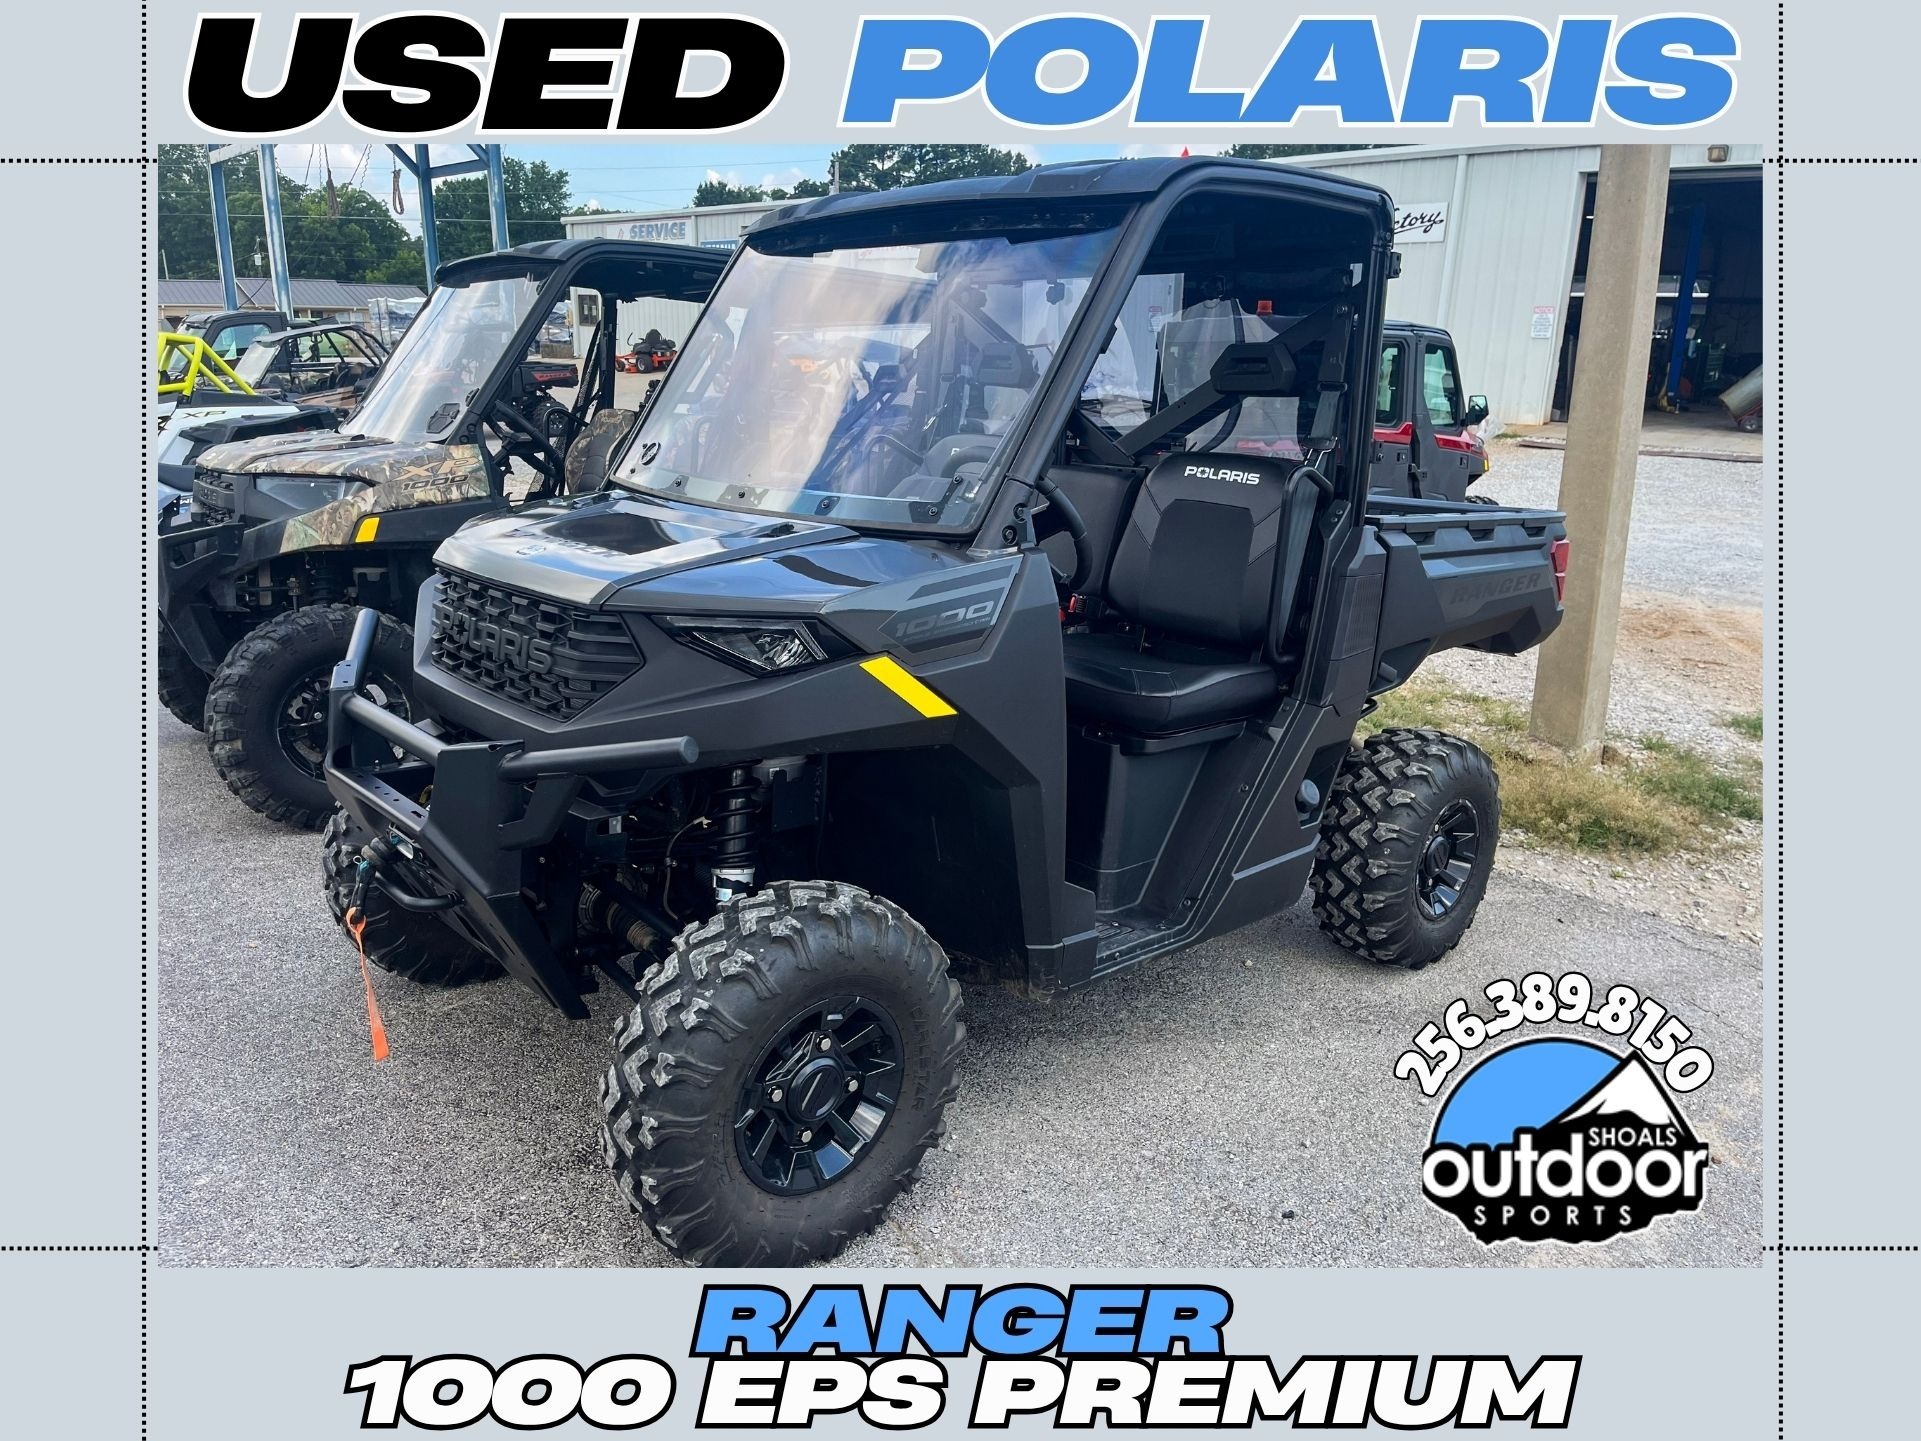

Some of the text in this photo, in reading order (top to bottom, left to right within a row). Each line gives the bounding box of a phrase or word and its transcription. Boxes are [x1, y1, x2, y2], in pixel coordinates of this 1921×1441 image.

[630, 222, 686, 240] SERVICE
[183, 410, 227, 419] XP
[391, 456, 480, 482] XP
[1184, 465, 1260, 485] POLARIS
[401, 474, 471, 493] 1000
[1449, 572, 1541, 605] RANGER
[895, 600, 995, 638] 1000
[435, 603, 552, 675] POLARIS
